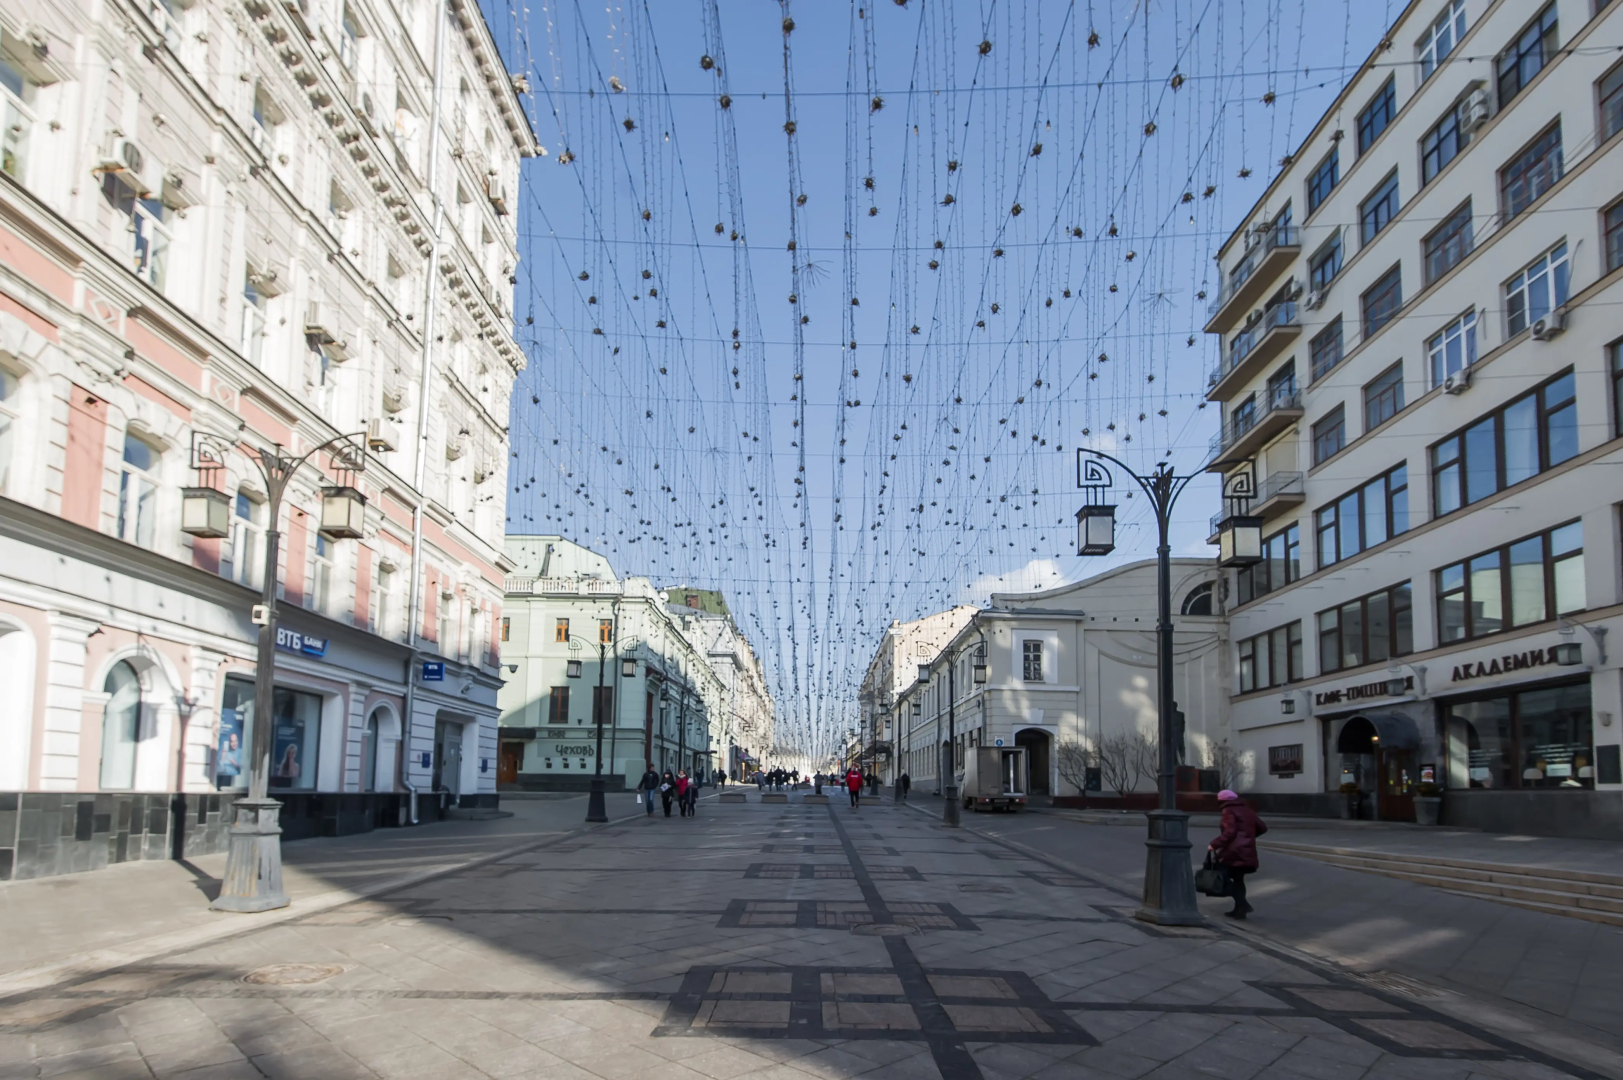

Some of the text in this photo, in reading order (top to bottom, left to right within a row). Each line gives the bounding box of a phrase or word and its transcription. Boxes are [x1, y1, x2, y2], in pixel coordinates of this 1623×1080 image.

[277, 627, 323, 650] ВТБ БАНК
[1452, 645, 1558, 682] АКАДЕМИЯ
[1315, 675, 1414, 706] КАФЕ-ПИЦЦЕЯ
